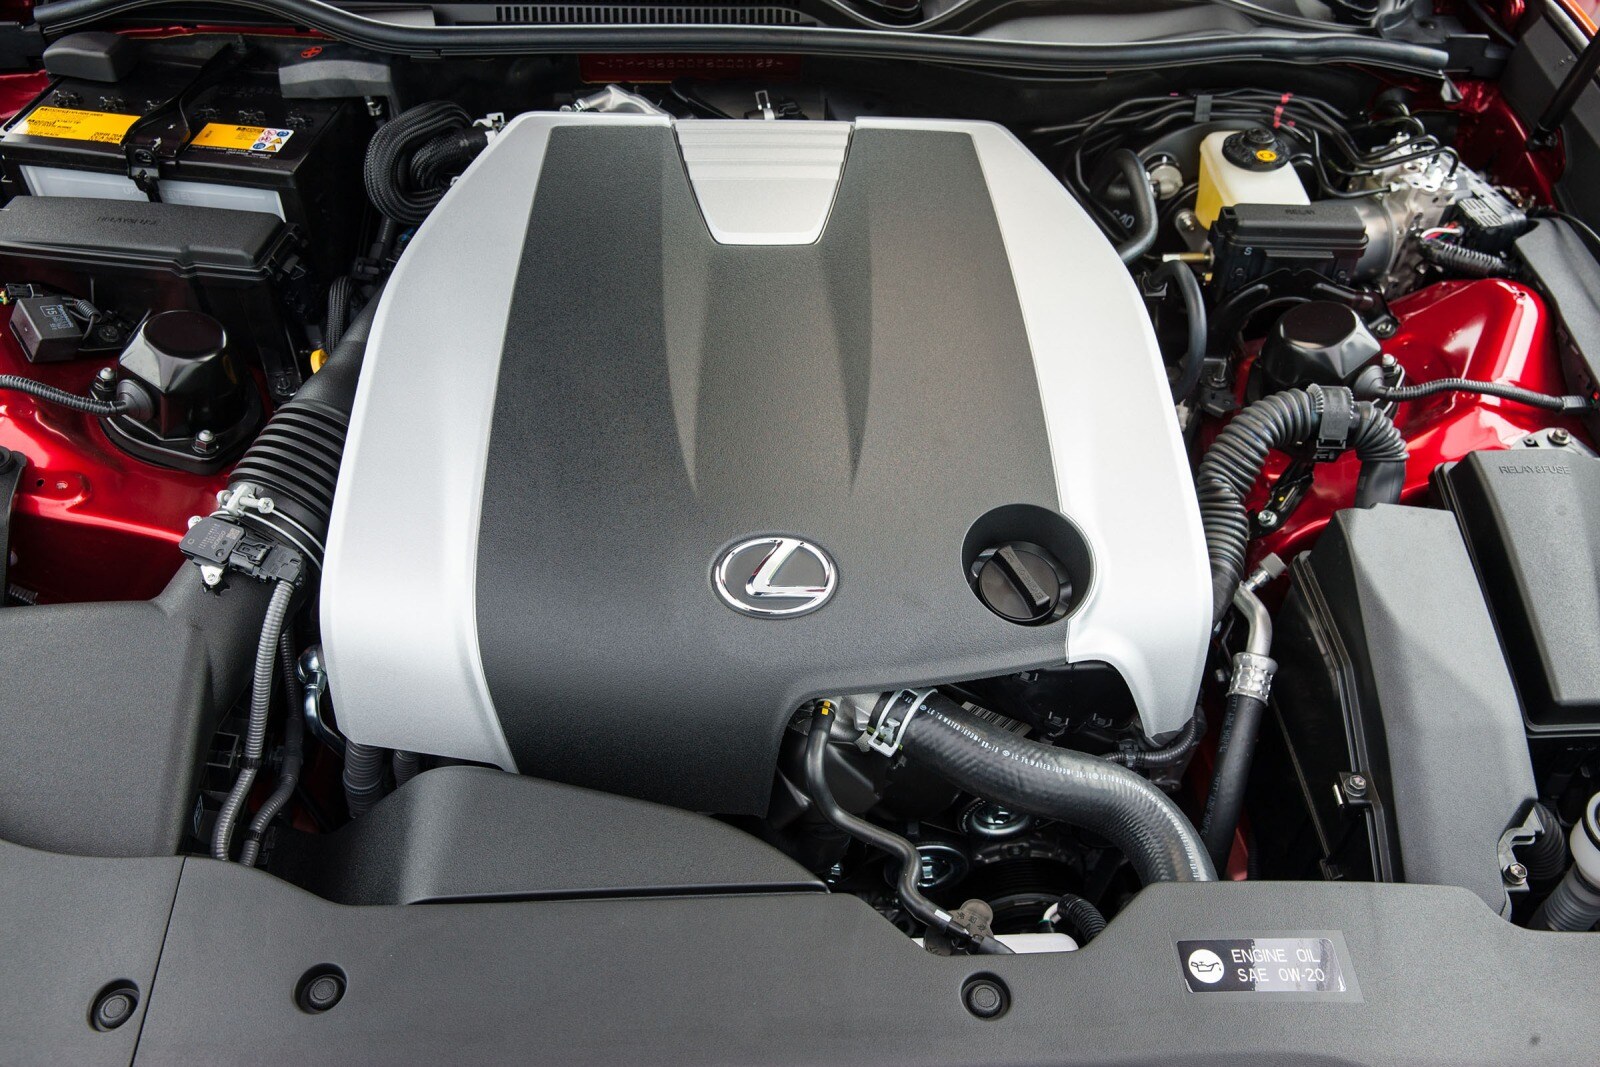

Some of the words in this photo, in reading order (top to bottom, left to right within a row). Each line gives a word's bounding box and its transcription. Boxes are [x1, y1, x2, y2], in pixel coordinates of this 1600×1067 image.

[1498, 465, 1572, 475] RELAY&FUSE
[943, 716, 961, 732] WATER
[1029, 759, 1051, 771] WATER
[1230, 948, 1288, 963] ENGINE
[1296, 949, 1321, 963] OIL
[1238, 967, 1269, 982] SAE
[1278, 967, 1326, 982] 0W-20
